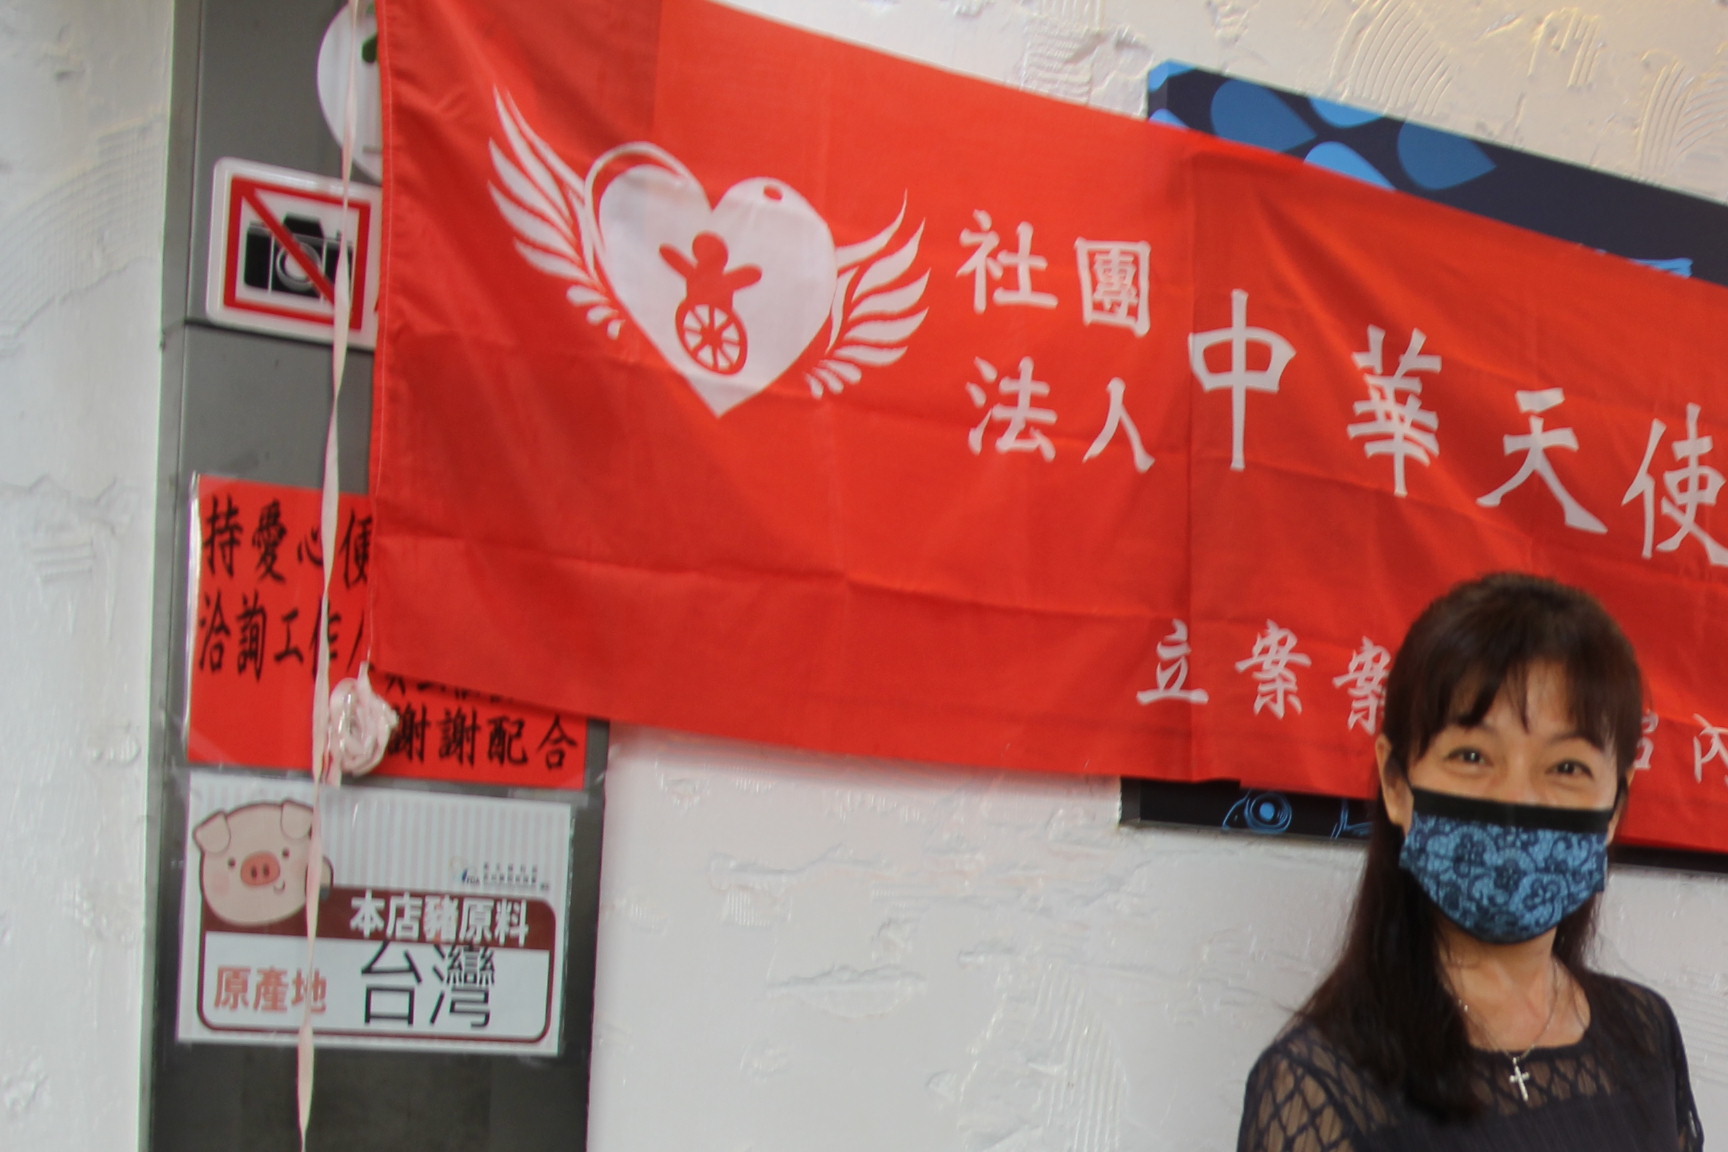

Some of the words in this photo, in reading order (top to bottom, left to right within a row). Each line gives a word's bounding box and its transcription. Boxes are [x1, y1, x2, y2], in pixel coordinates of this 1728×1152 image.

[956, 208, 1152, 338] 社團
[964, 355, 1156, 473] 法人
[349, 888, 530, 948] 本店豬原料
[213, 964, 328, 1014] 原產地
[360, 938, 495, 1028] 台灣
